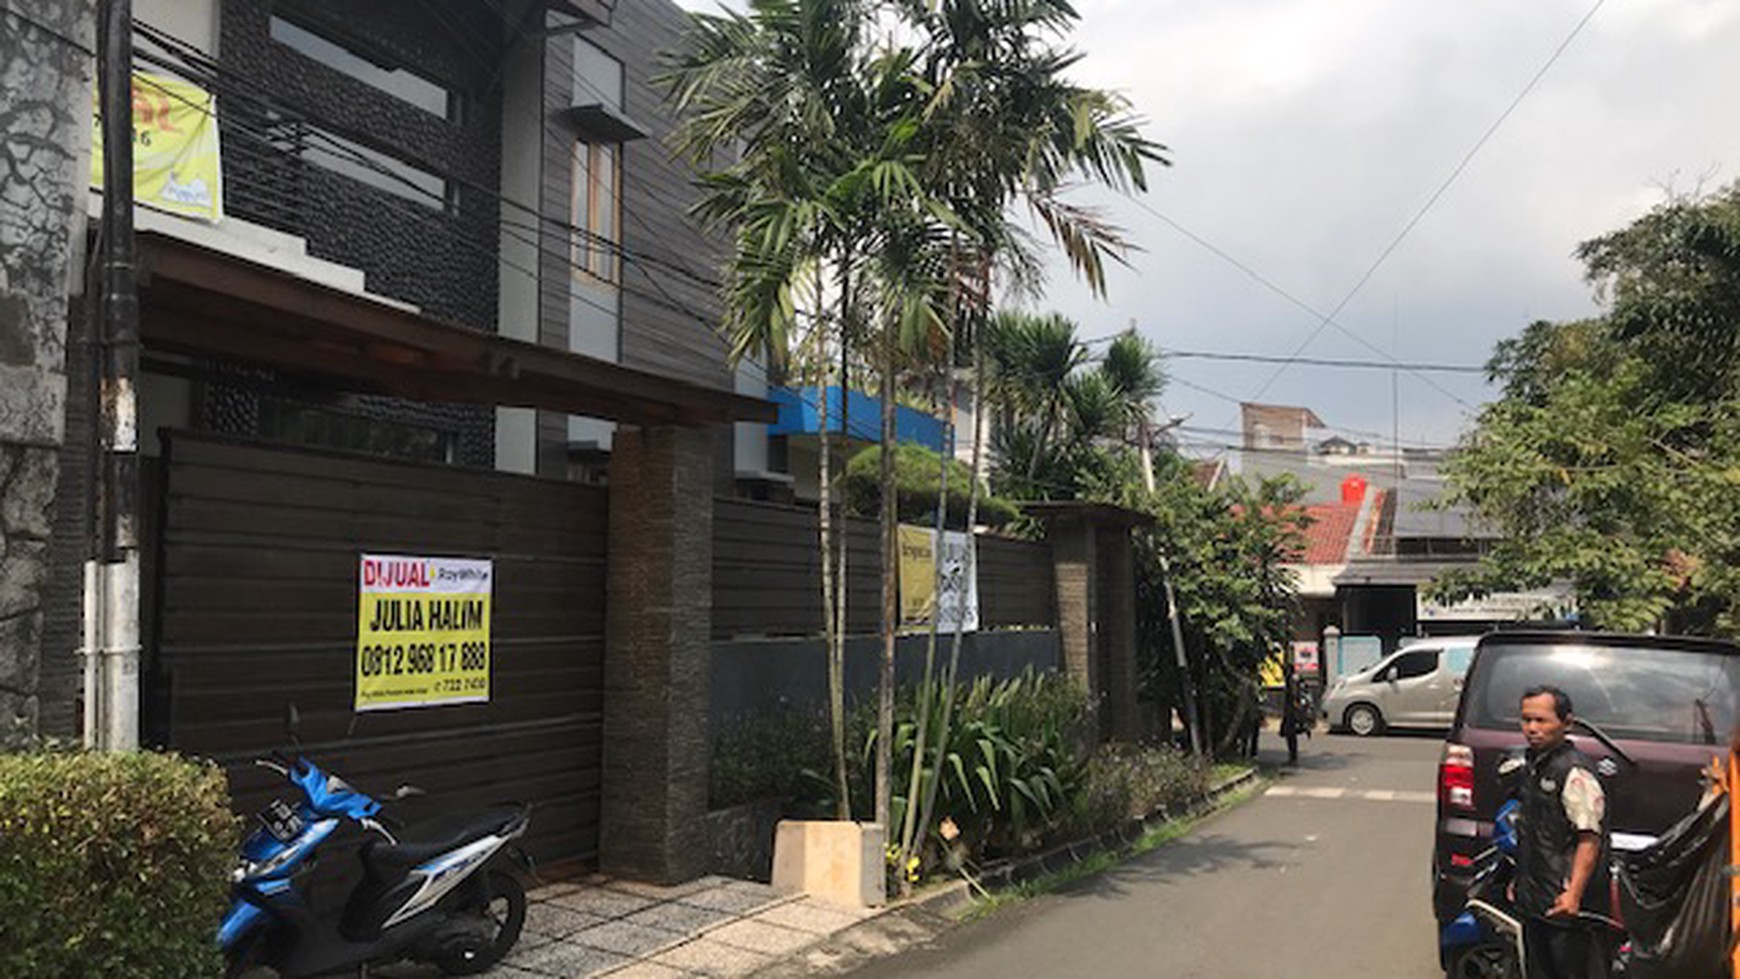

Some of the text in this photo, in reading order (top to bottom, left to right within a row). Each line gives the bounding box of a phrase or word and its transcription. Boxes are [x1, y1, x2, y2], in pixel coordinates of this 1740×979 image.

[364, 560, 430, 588] DIJUAL
[370, 599, 483, 631] JULIA HALIM
[361, 645, 404, 677] 0812
[439, 643, 456, 672] 17
[461, 641, 486, 671] 888
